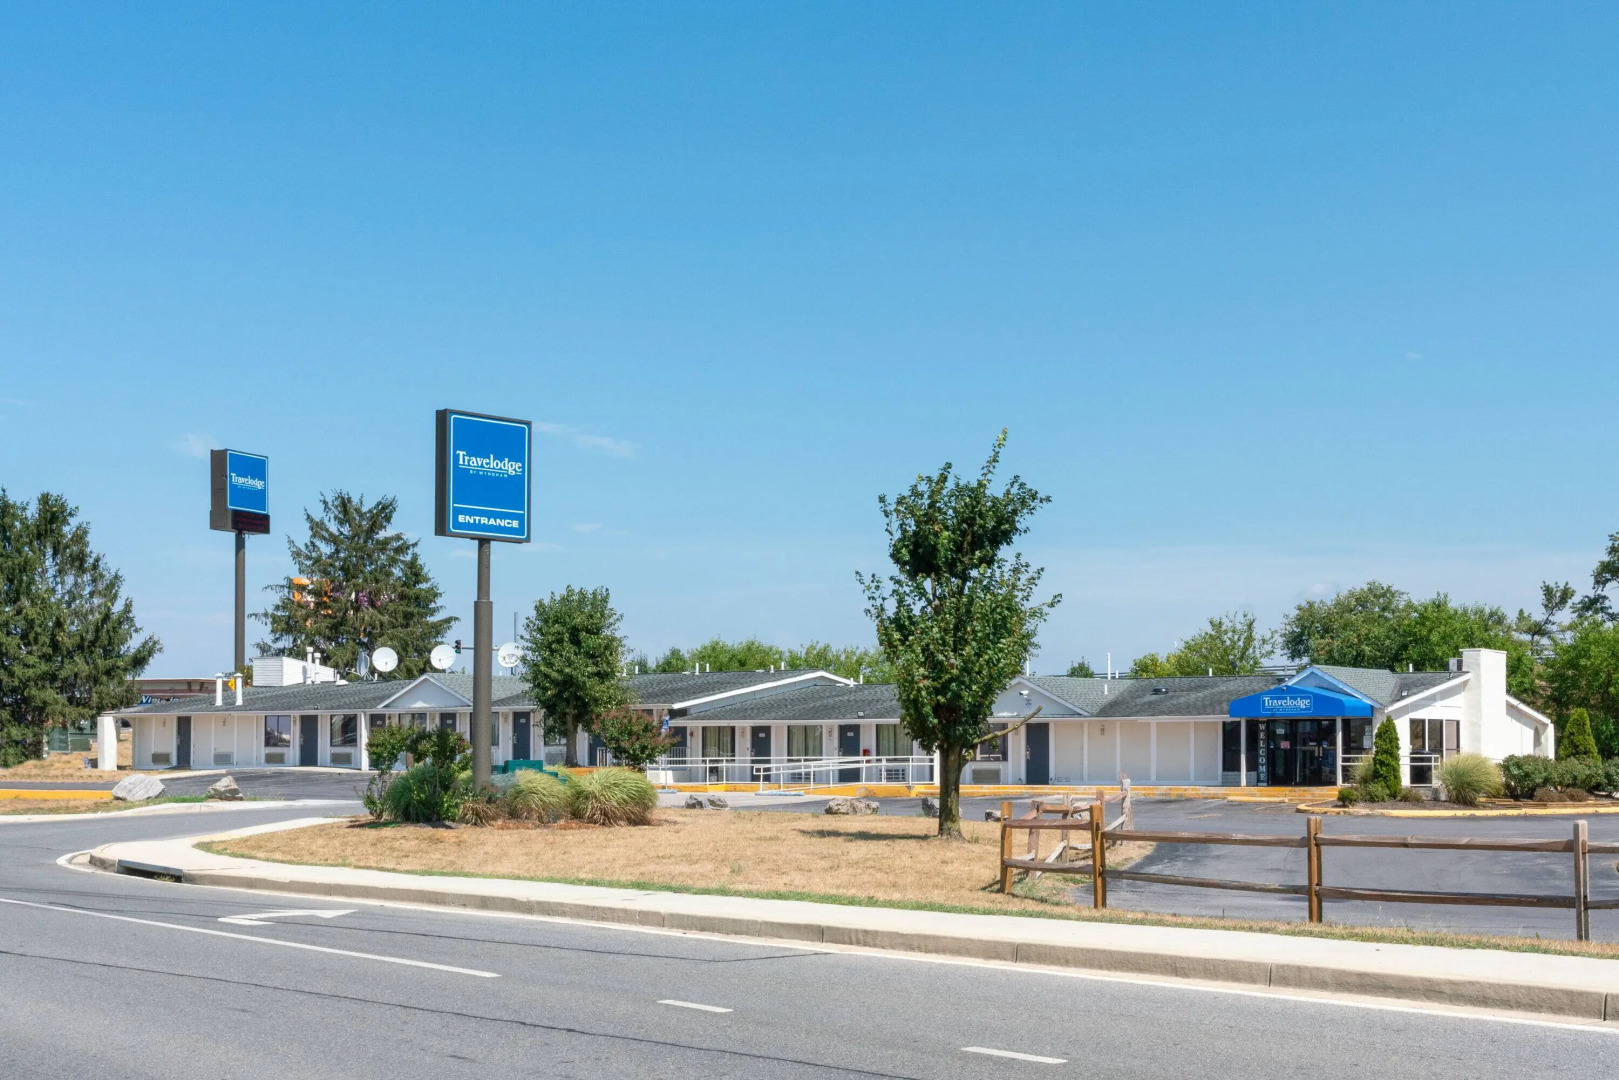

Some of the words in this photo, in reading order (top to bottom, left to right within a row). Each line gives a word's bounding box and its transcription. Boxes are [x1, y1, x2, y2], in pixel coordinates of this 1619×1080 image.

[456, 450, 522, 475] Travelodge
[231, 473, 264, 489] Travelodge
[458, 515, 519, 527] ENTRANCE
[1263, 697, 1310, 708] Travelodge
[1258, 723, 1266, 781] WELCOME
